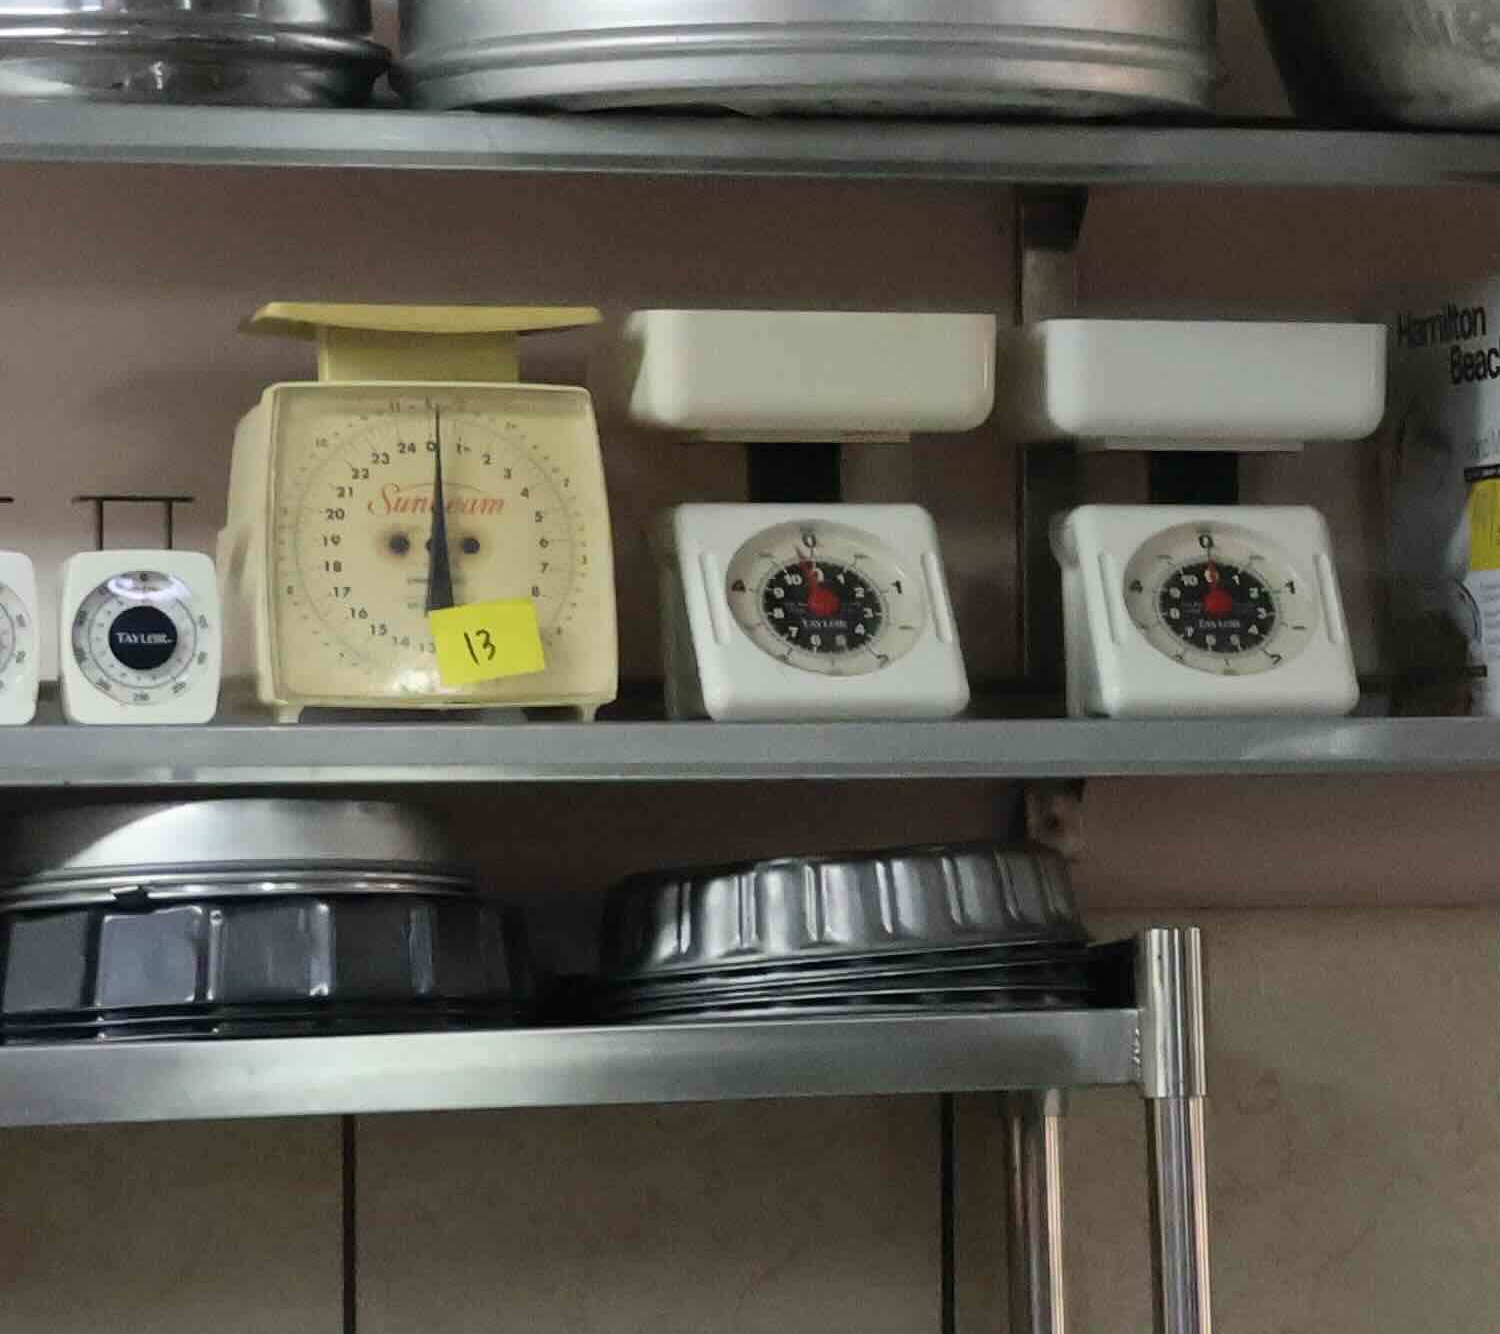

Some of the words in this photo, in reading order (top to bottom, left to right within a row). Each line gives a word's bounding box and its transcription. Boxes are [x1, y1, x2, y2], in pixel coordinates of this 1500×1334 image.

[397, 442, 416, 454] 24
[371, 453, 390, 465] 23
[352, 468, 369, 480] 22
[336, 486, 353, 499] 21
[326, 508, 345, 520] 20
[323, 535, 341, 547] 19
[802, 532, 817, 549] 0
[1198, 534, 1214, 549] 0
[325, 560, 342, 572] 18
[784, 573, 802, 585] 10
[333, 586, 351, 598] 17
[350, 607, 369, 619] 16
[370, 623, 388, 636] 15
[464, 628, 497, 666] 13
